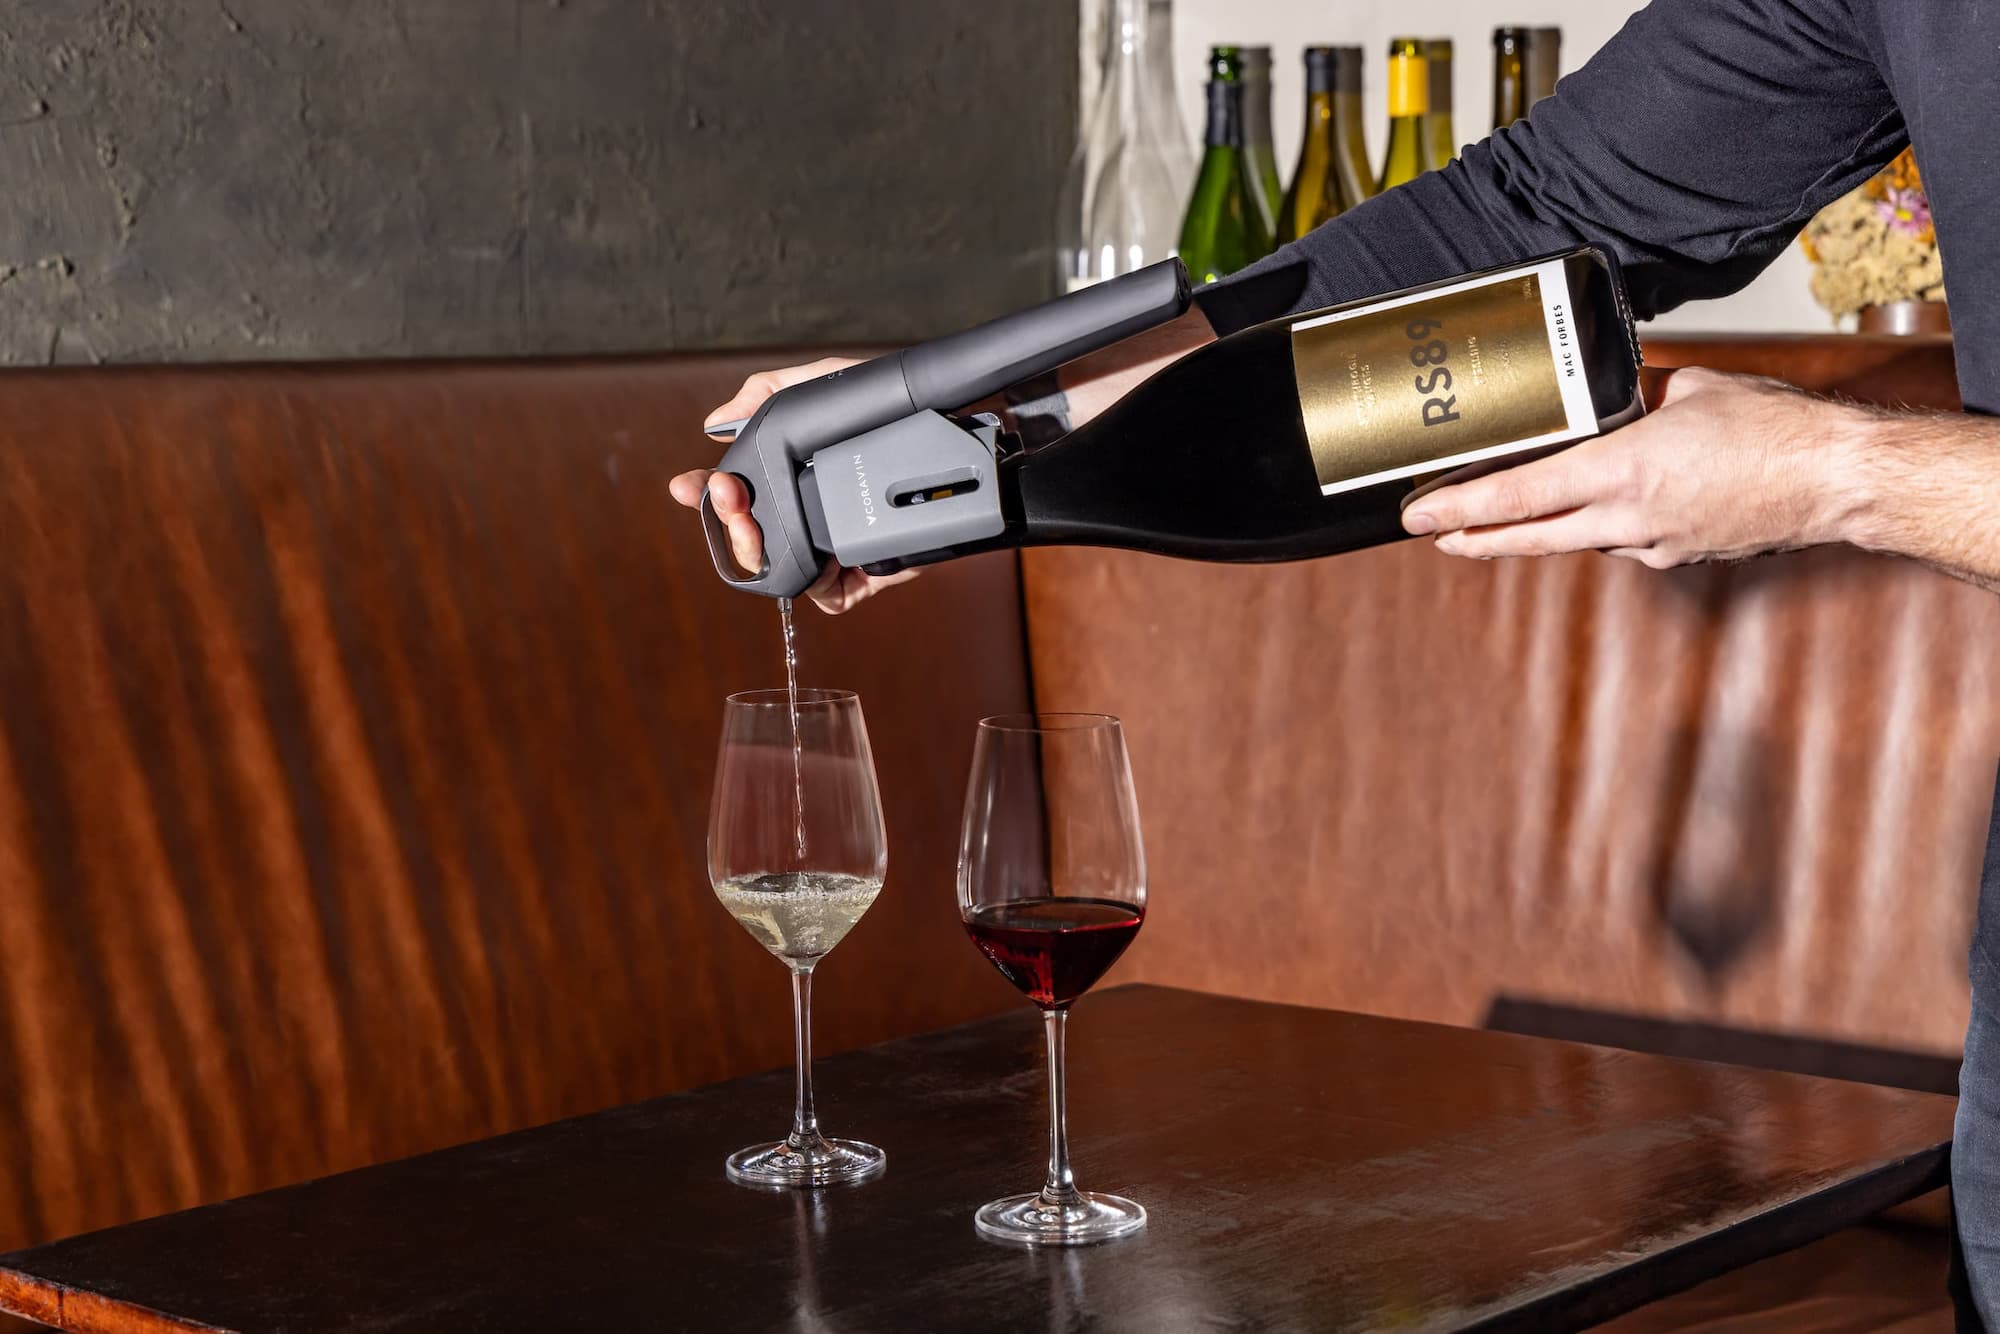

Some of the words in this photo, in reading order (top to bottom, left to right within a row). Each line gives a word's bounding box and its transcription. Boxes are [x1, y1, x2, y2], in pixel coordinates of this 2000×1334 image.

[1553, 303, 1568, 347] FORBES
[1406, 319, 1460, 427] RS89
[1564, 350, 1575, 377] MAC
[853, 454, 874, 513] CORAVIN
